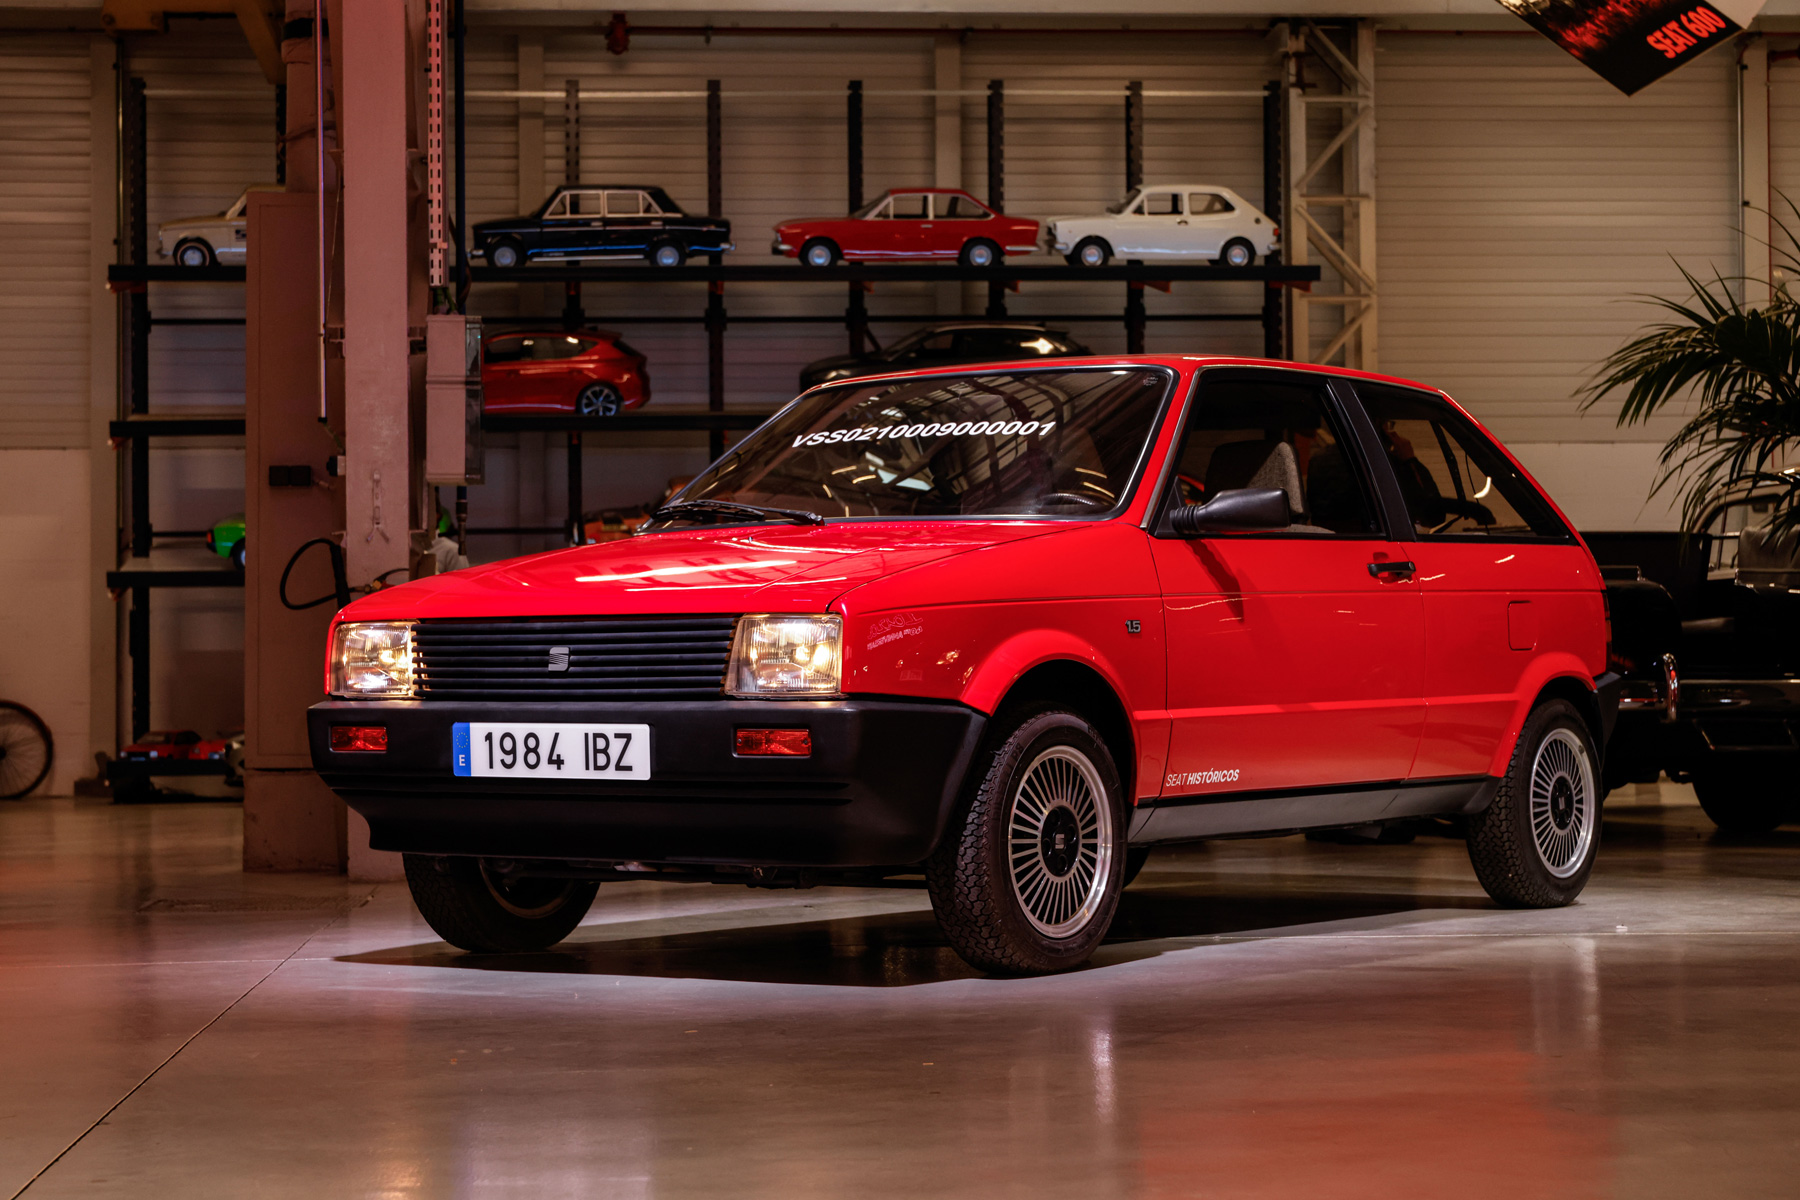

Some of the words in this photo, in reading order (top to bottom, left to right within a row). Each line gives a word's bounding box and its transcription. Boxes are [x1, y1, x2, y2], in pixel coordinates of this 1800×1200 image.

[1646, 20, 1698, 59] SEAT
[1680, 6, 1727, 38] 600
[791, 421, 1056, 448] VSS0210009000001
[459, 754, 466, 766] E
[484, 732, 565, 770] 1984
[584, 732, 633, 771] IBZ
[1165, 773, 1188, 787] SEAT
[1186, 767, 1240, 786] HISTÓRICOS
